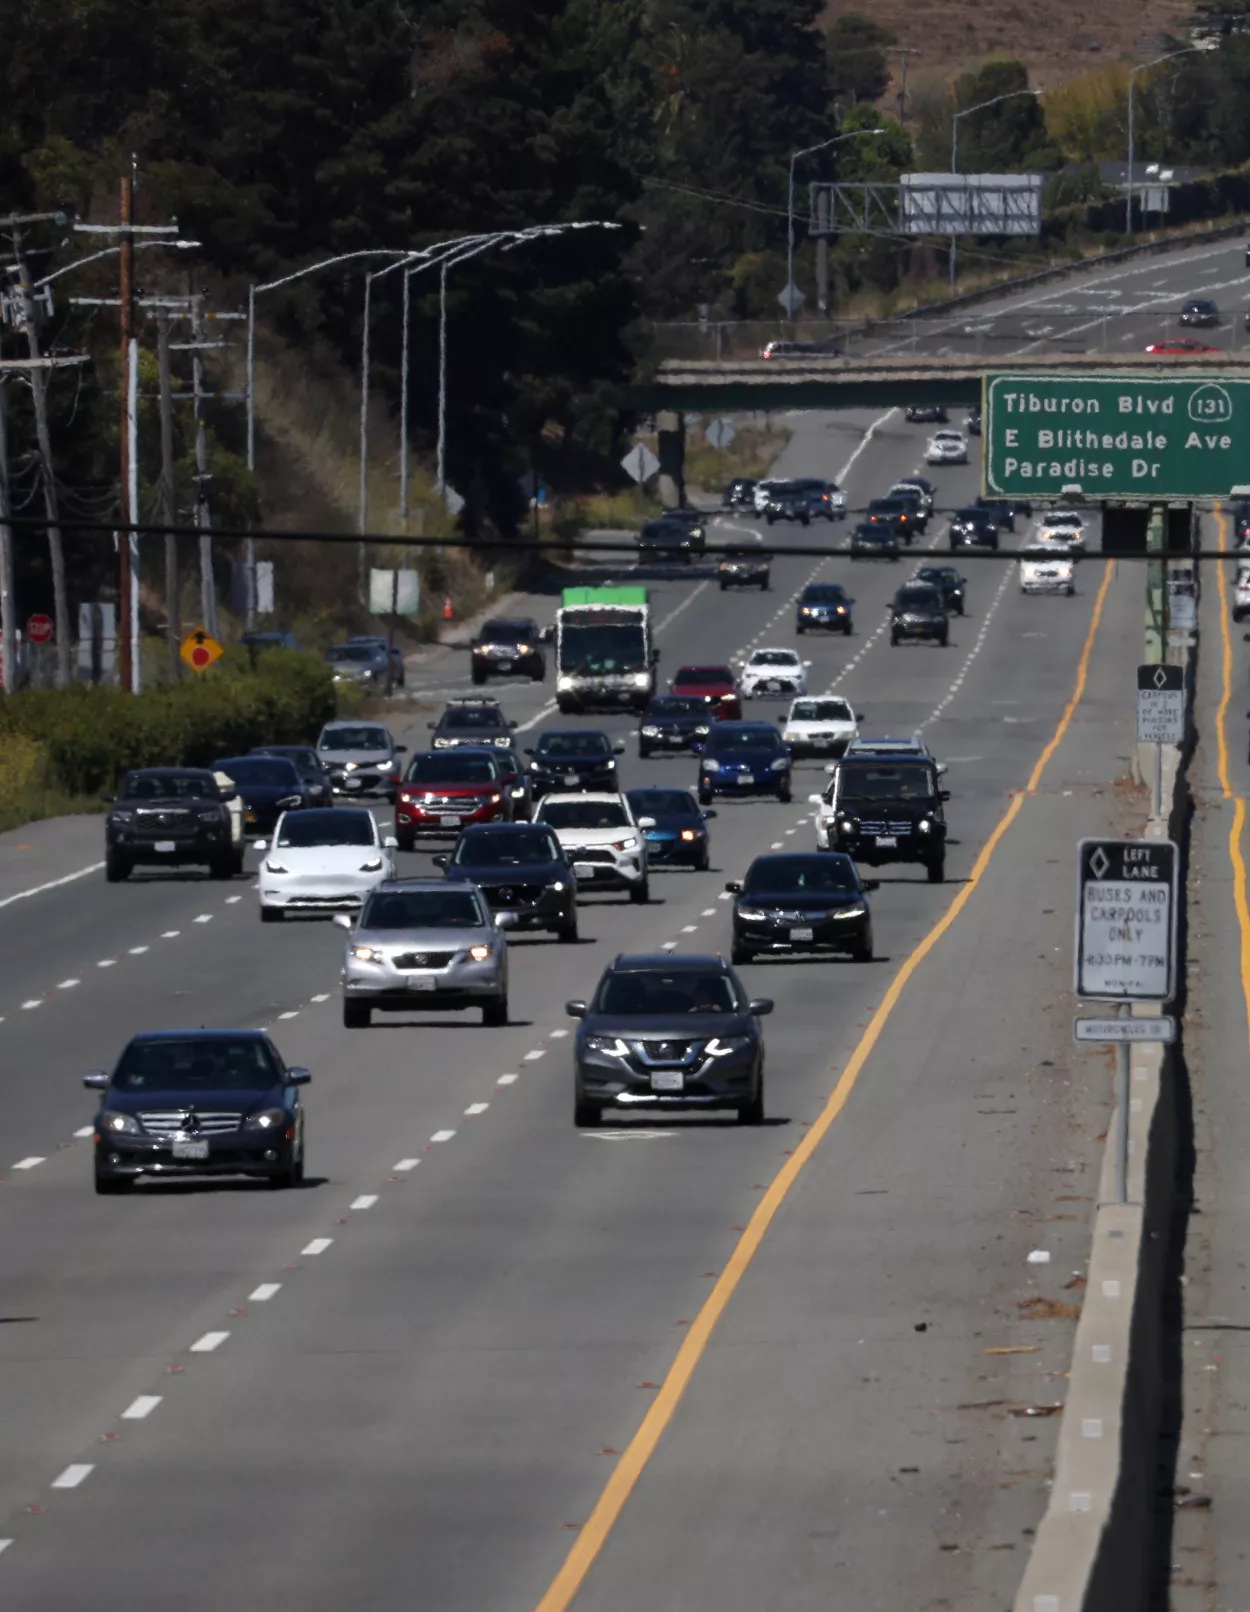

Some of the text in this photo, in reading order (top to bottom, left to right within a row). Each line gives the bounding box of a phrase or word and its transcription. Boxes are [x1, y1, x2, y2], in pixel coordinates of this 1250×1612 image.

[1003, 393, 1226, 414] Tiburon Blvd 131
[1004, 429, 1232, 449] E Blithedale Ave
[1004, 458, 1114, 478] Paradise
[1132, 459, 1161, 478] Dr
[1123, 849, 1151, 862] LEFT
[1122, 865, 1159, 879] LANE
[1087, 887, 1166, 903] BUSES AND
[1090, 906, 1162, 923] CARPOOLS
[1108, 927, 1144, 942] ONLY
